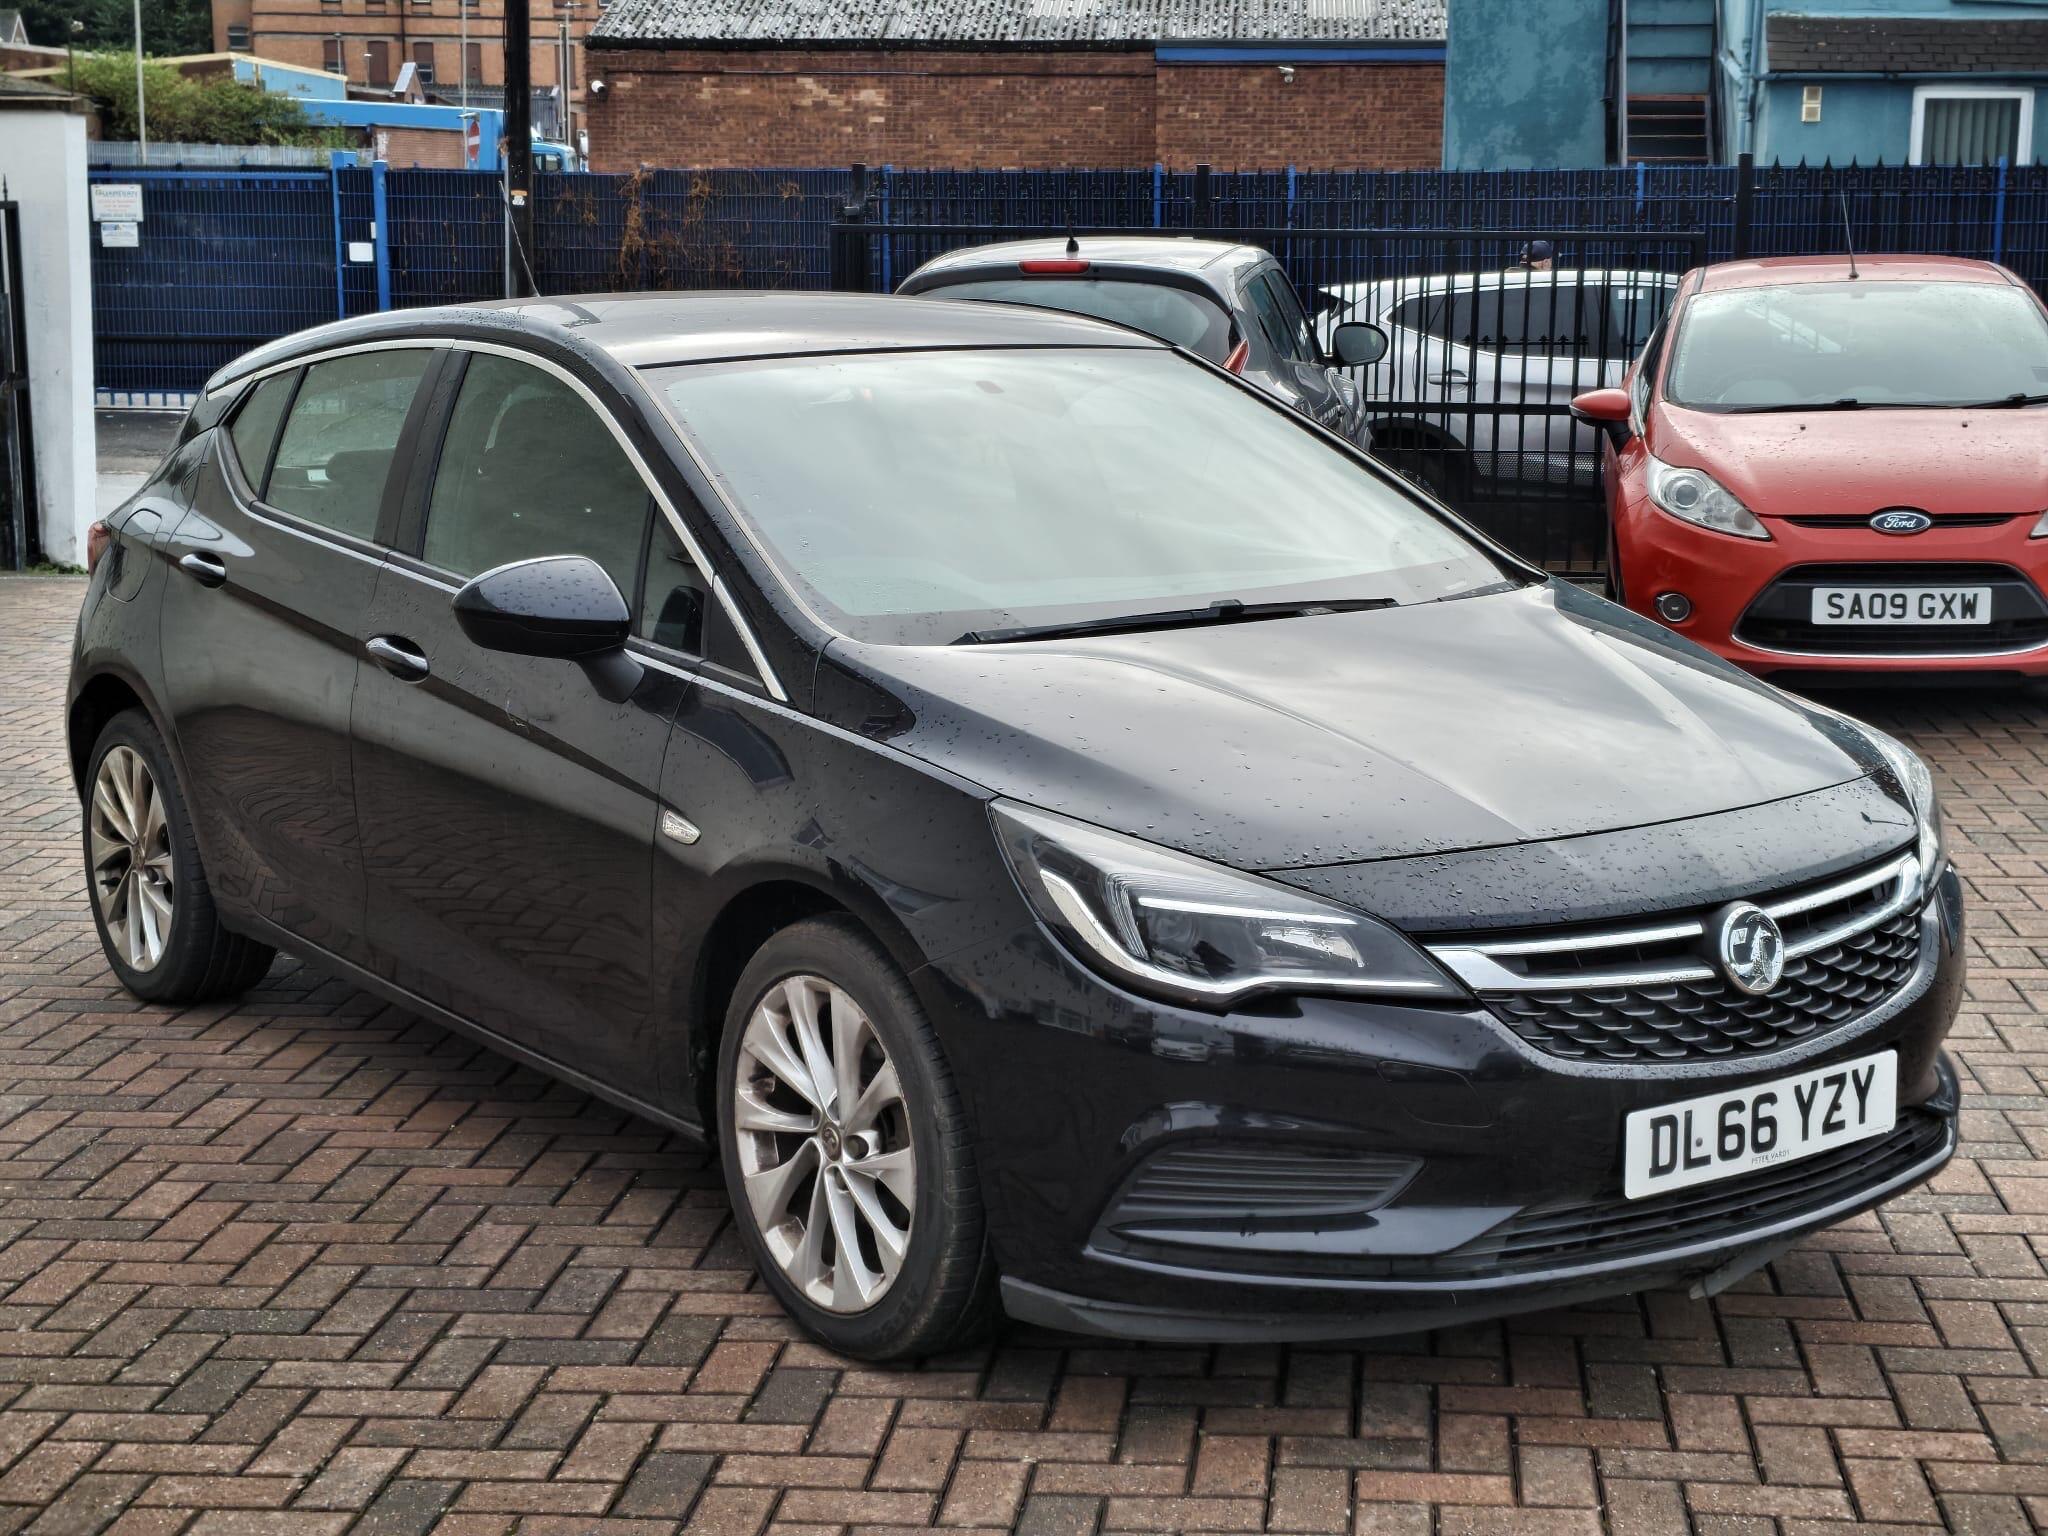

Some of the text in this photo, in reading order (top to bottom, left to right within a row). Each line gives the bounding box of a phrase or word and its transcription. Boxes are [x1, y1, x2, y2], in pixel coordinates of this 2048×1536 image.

[1884, 515, 1917, 528] Ford
[1827, 592, 1979, 619] SA09 GXW
[1649, 1064, 1876, 1179] DL66 YZY
